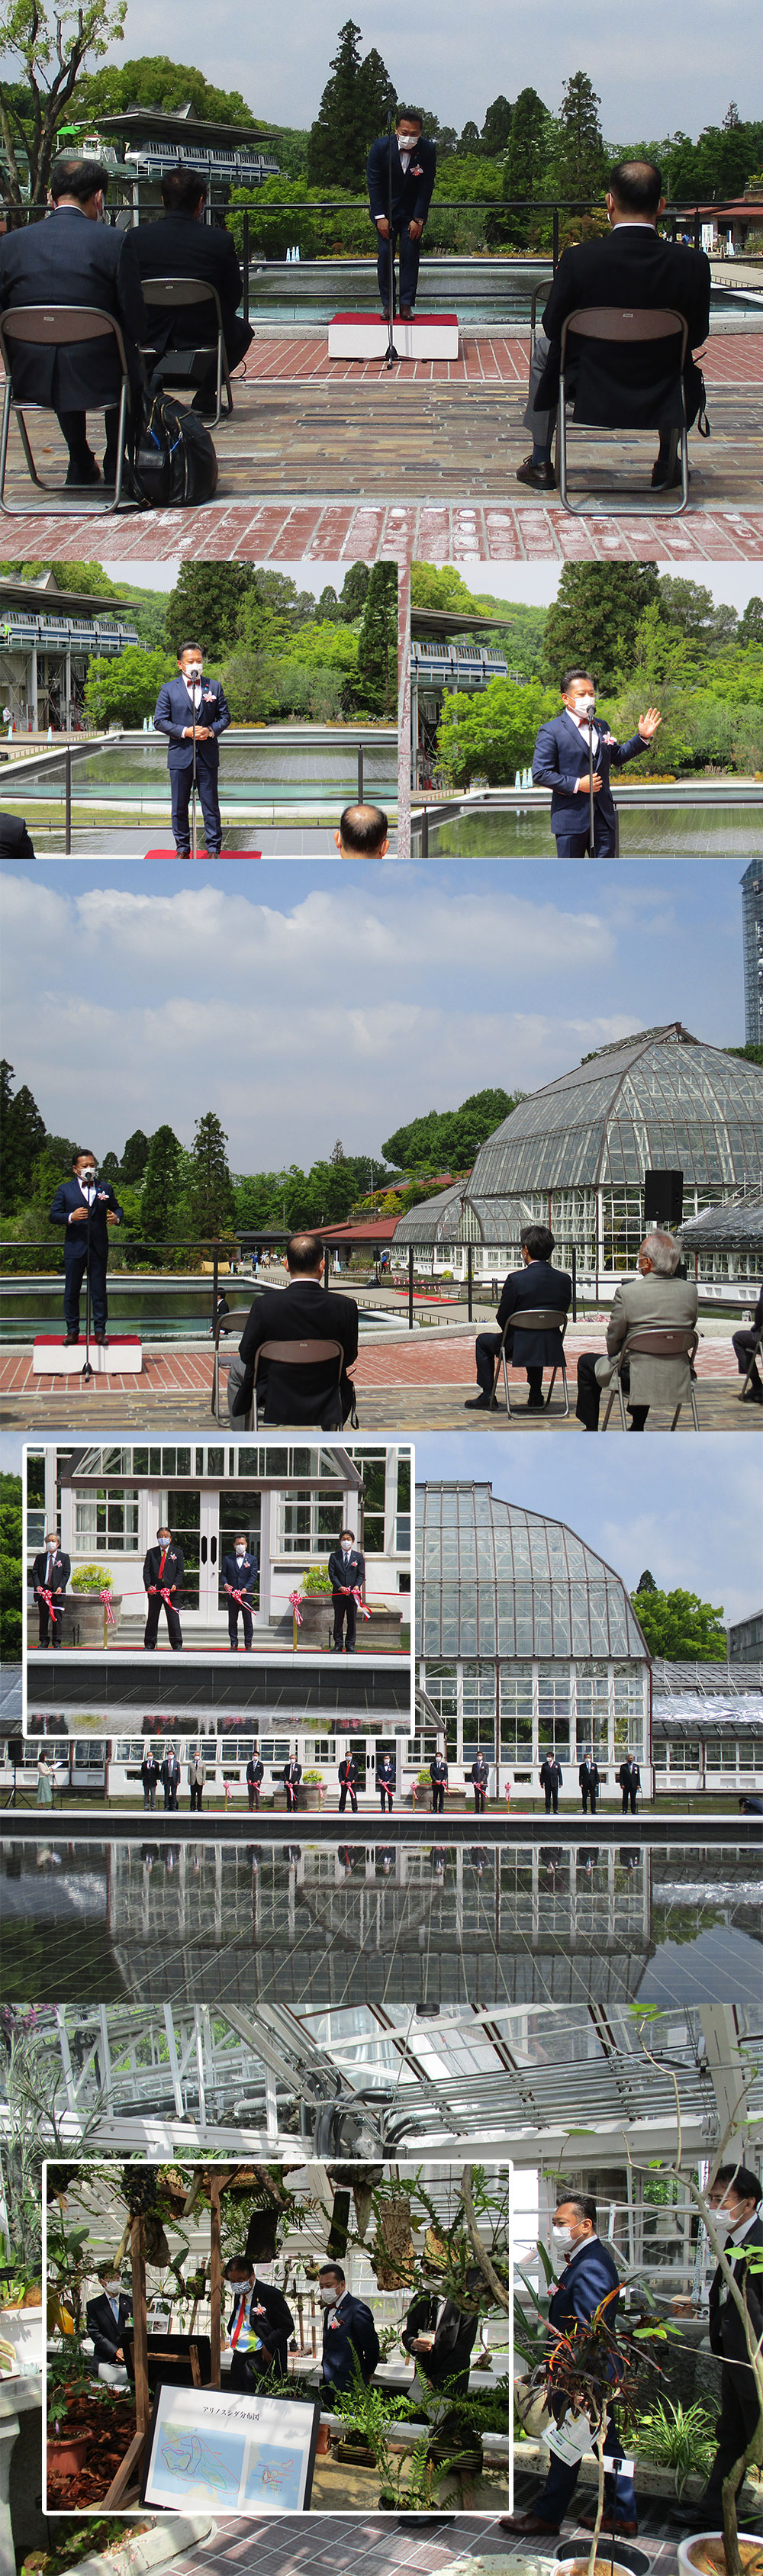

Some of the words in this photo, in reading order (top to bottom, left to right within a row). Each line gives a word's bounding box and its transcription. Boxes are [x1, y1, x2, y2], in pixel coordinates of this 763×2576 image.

[203, 2406, 260, 2421] アリノスシダ分布図
